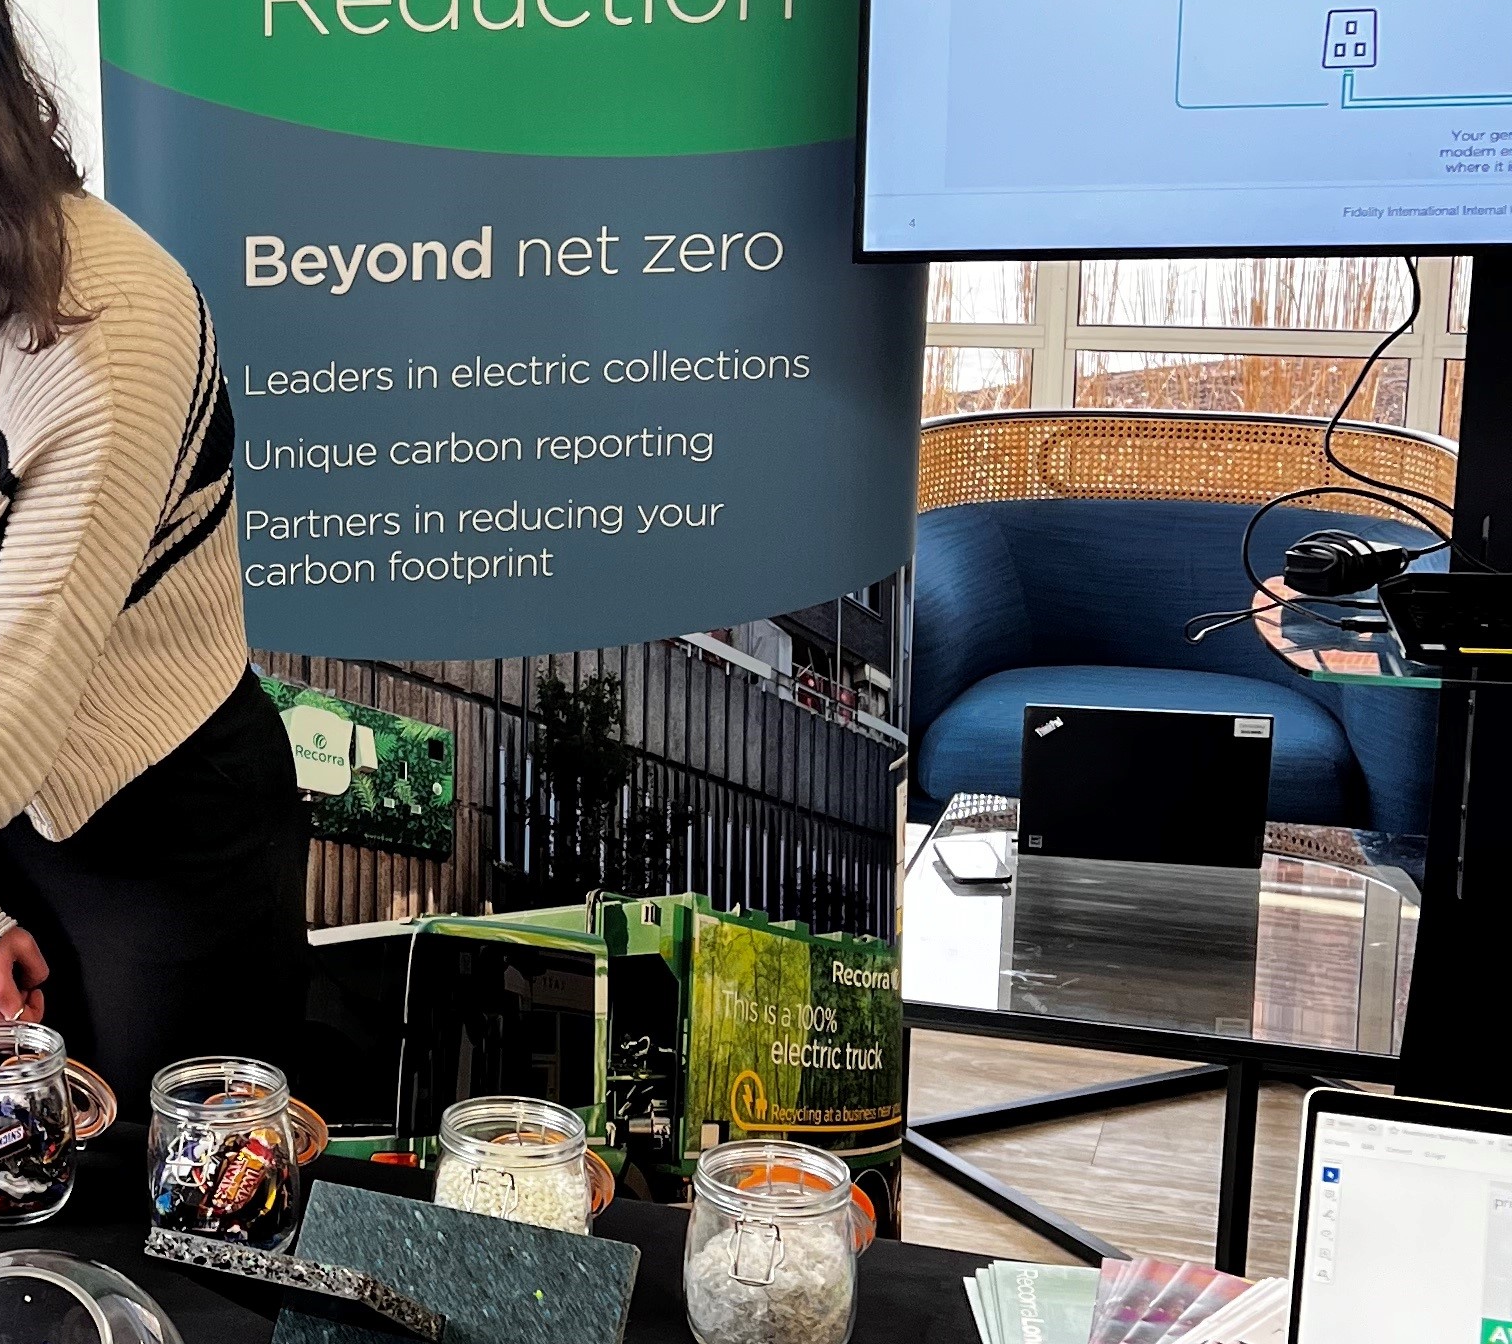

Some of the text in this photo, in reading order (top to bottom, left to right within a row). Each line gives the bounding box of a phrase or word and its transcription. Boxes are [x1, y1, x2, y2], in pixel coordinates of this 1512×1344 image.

[1451, 129, 1487, 142] Your
[1445, 162, 1491, 174] where
[1493, 160, 1505, 173] it
[1342, 204, 1507, 220] Fidelity International Internal
[243, 225, 785, 295] Beyond net zero
[243, 347, 811, 397] Leaders in electric collections
[244, 426, 715, 476] Unique carbon reporting
[245, 498, 725, 541] Partners in reducing your
[244, 547, 554, 588] carbon footprint
[295, 744, 345, 767] Recorra
[832, 960, 890, 991] Recorra
[722, 989, 838, 1034] This is a 100%
[771, 1033, 883, 1070] electric truck
[771, 1103, 822, 1125] Recycling
[823, 1106, 834, 1123] at
[834, 1109, 842, 1123] a
